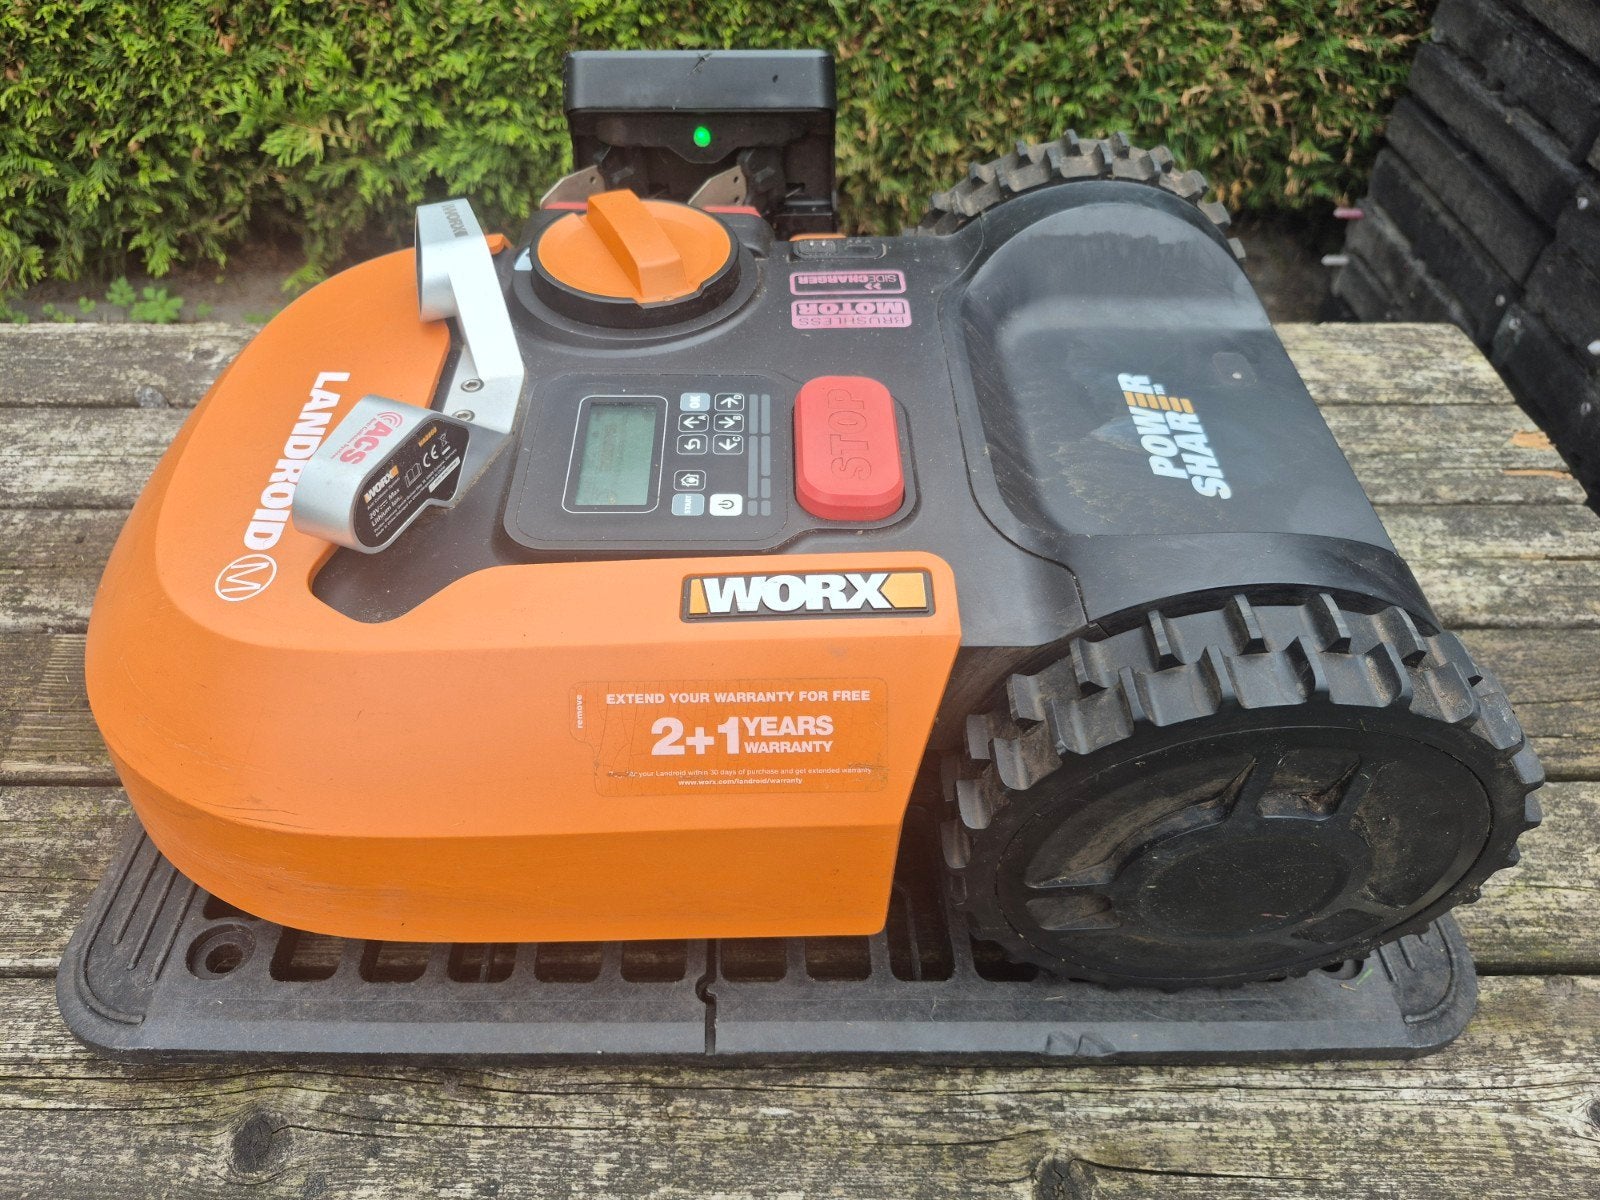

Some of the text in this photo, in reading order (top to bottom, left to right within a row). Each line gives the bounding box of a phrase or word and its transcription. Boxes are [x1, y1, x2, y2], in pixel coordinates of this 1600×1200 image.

[798, 274, 897, 285] SIDECHARGER
[798, 302, 904, 315] MOTOR
[798, 316, 905, 326] BRUSHLESS
[689, 395, 701, 409] OK
[827, 388, 872, 480] STOP
[1118, 373, 1189, 480] POWER
[339, 420, 394, 465] ACS
[1158, 395, 1232, 500] SHARE
[243, 371, 350, 551] LANDROID
[365, 468, 395, 503] WORX
[702, 572, 893, 614] WORX
[606, 690, 871, 705] EXTEND YOUR WARRANTY FOR FREE
[651, 714, 834, 756] 2+1 YEARS
[743, 740, 833, 754] WARRANTY
[655, 769, 686, 777] Landroid
[687, 769, 709, 777] within
[720, 769, 737, 777] days
[738, 768, 746, 776] of
[746, 767, 779, 777] purchase
[780, 767, 794, 775] and
[795, 767, 807, 776] get
[807, 766, 840, 775] extended
[841, 766, 872, 776] warranty
[677, 776, 803, 787] www.worx.com/landroid/warranty
